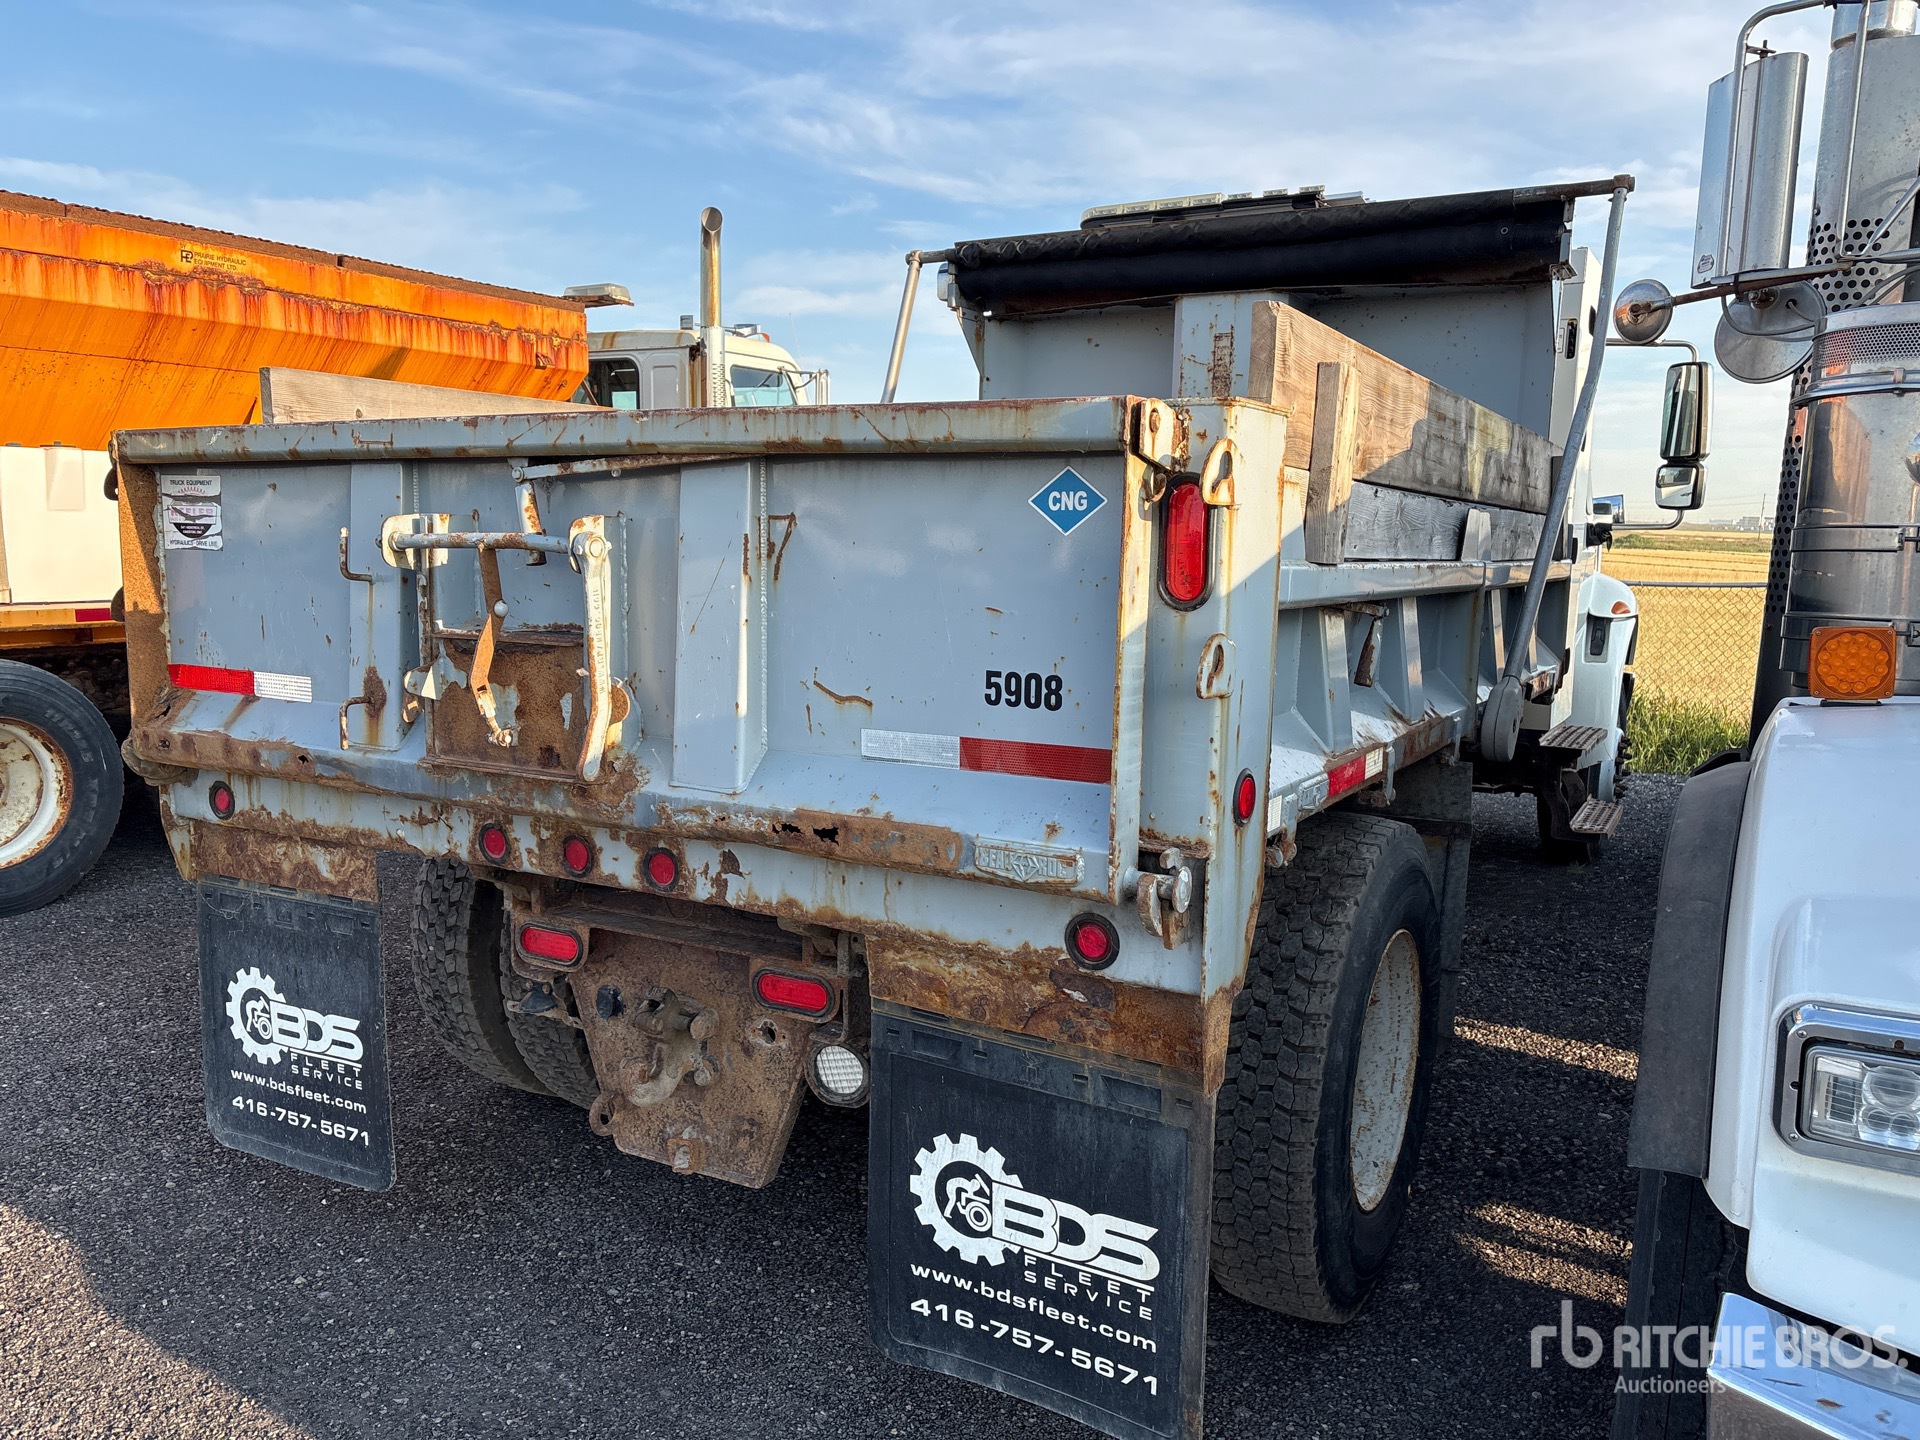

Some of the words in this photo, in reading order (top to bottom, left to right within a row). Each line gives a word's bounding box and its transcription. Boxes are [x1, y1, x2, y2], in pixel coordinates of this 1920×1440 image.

[194, 251, 215, 261] PRAIRIE
[216, 255, 247, 266] HYDRAULIC
[194, 258, 225, 269] EQUIPMENT
[1048, 490, 1088, 511] CNG
[984, 669, 1063, 711] 5908
[270, 1000, 364, 1061] BDS
[290, 1052, 362, 1078] FLEET
[291, 1064, 363, 1090] SERVICE
[230, 1069, 367, 1114] www.bdsfleet.com
[232, 1095, 370, 1146] 416-757-5671
[991, 1181, 1160, 1281] BDS
[1024, 1254, 1152, 1303] FLEET
[1024, 1270, 1152, 1321] SERVICE
[910, 1263, 1157, 1353] www.bdsfleet.com
[910, 1298, 1157, 1396] 416-757-5671
